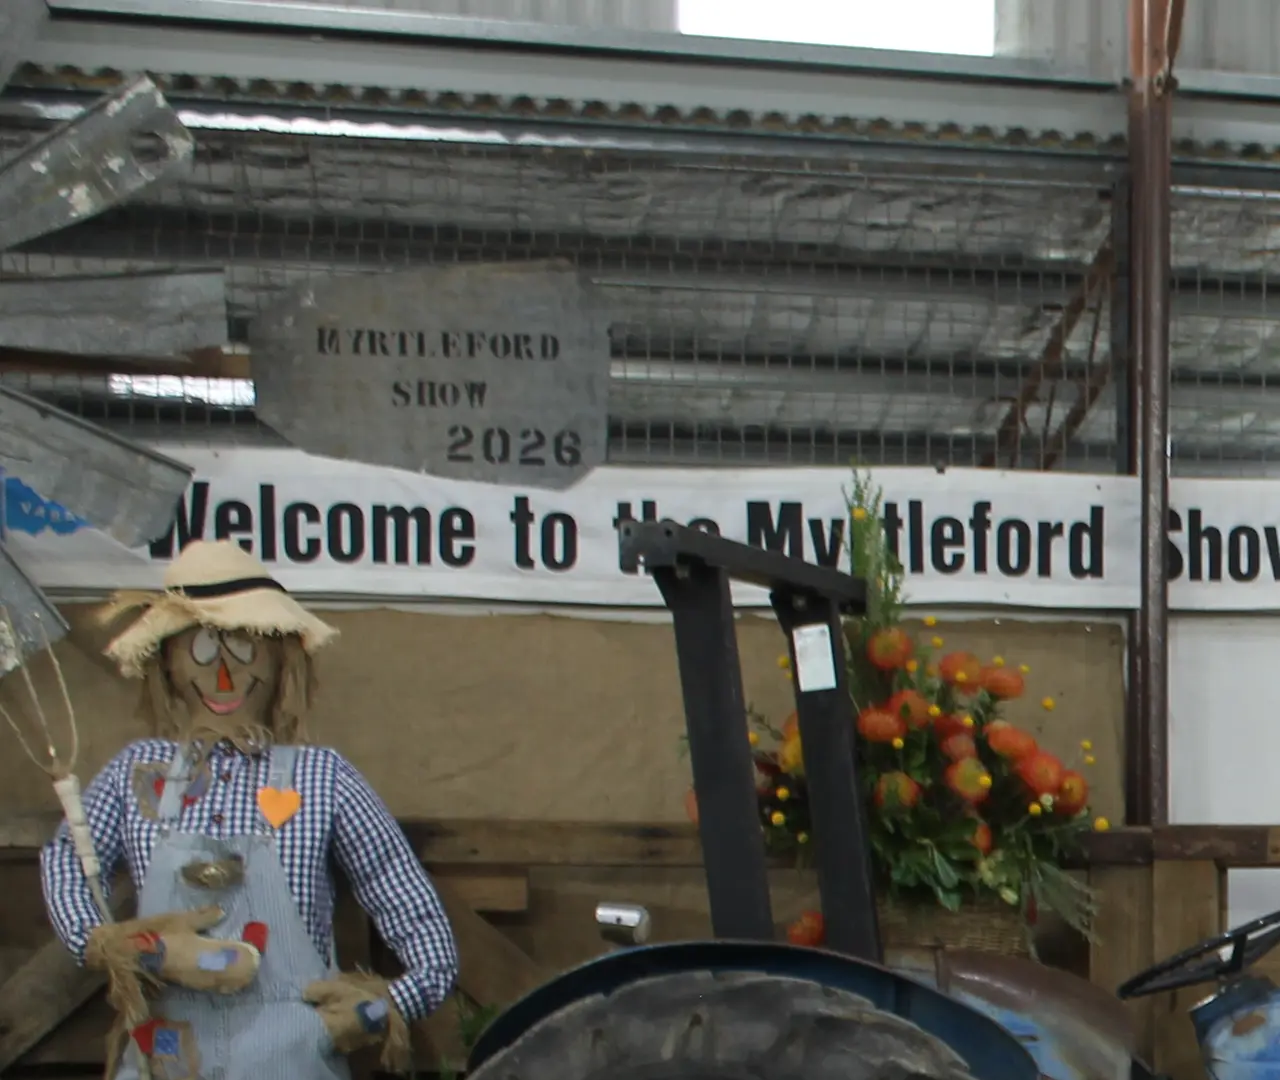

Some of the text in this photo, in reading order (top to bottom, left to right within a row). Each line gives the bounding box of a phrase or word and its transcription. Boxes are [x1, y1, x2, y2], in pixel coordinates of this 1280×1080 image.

[316, 327, 560, 361] MYRTLEFORD
[391, 379, 487, 409] SHOW
[447, 425, 582, 467] 2026
[149, 482, 476, 567] Welcome
[511, 496, 577, 571] to
